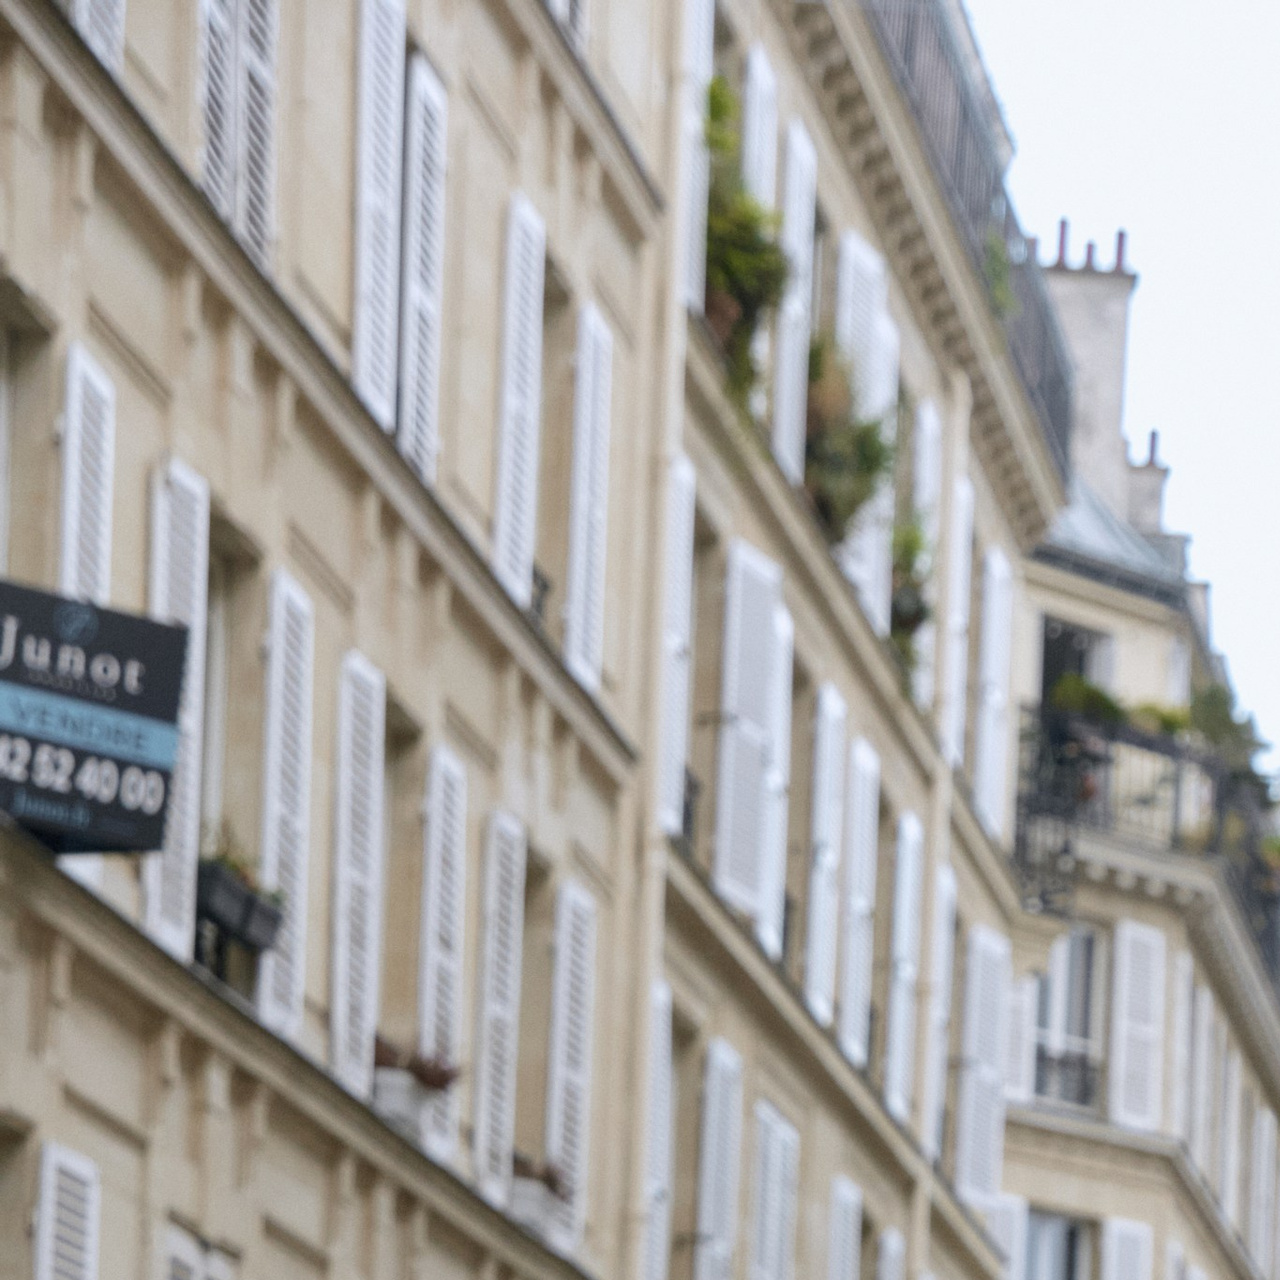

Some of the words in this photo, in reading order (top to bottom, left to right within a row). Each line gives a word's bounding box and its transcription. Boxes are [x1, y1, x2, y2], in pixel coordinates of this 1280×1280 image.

[0, 614, 145, 695] Junot
[10, 697, 150, 749] VENDRE
[75, 755, 119, 803] 40
[119, 766, 165, 815] 00
